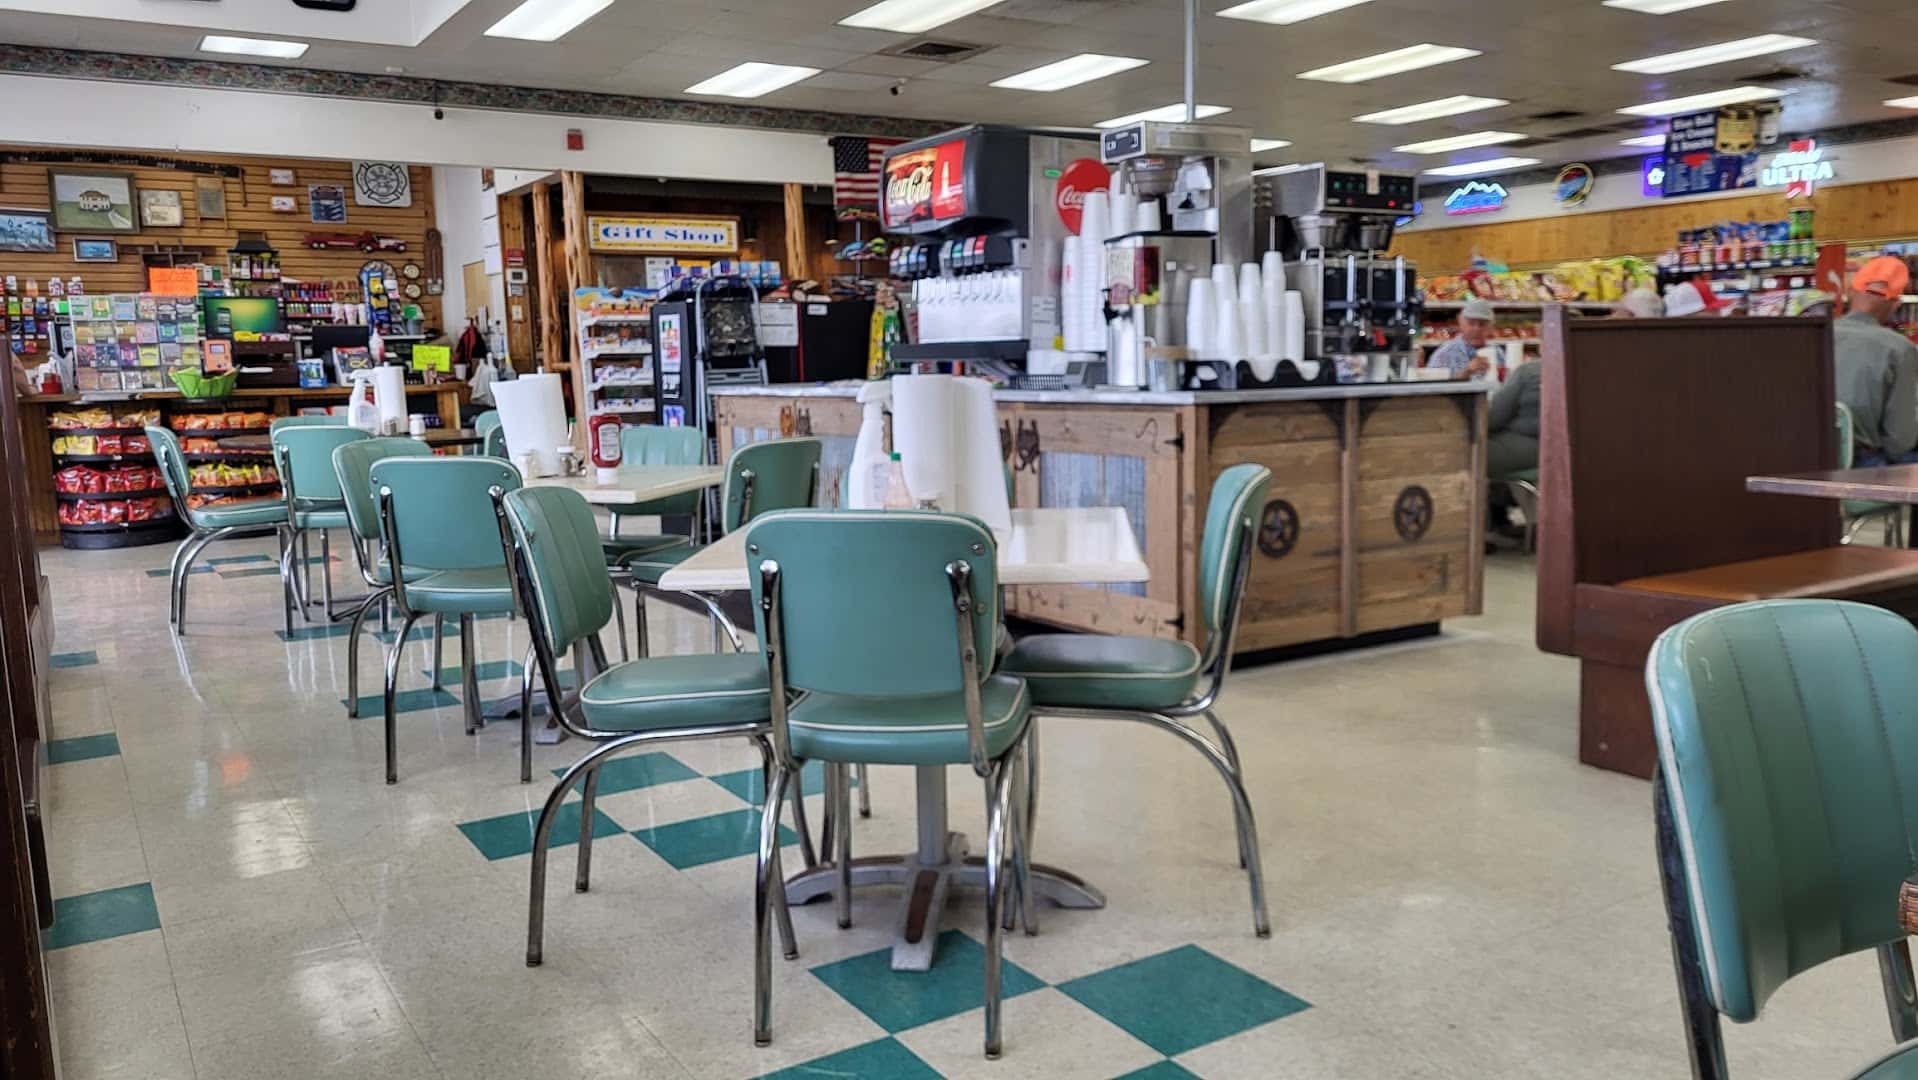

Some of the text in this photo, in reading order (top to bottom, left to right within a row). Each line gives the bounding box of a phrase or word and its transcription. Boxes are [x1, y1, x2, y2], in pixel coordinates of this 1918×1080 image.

[1762, 161, 1833, 186] ULTRA
[602, 226, 724, 244] Gift Shop
